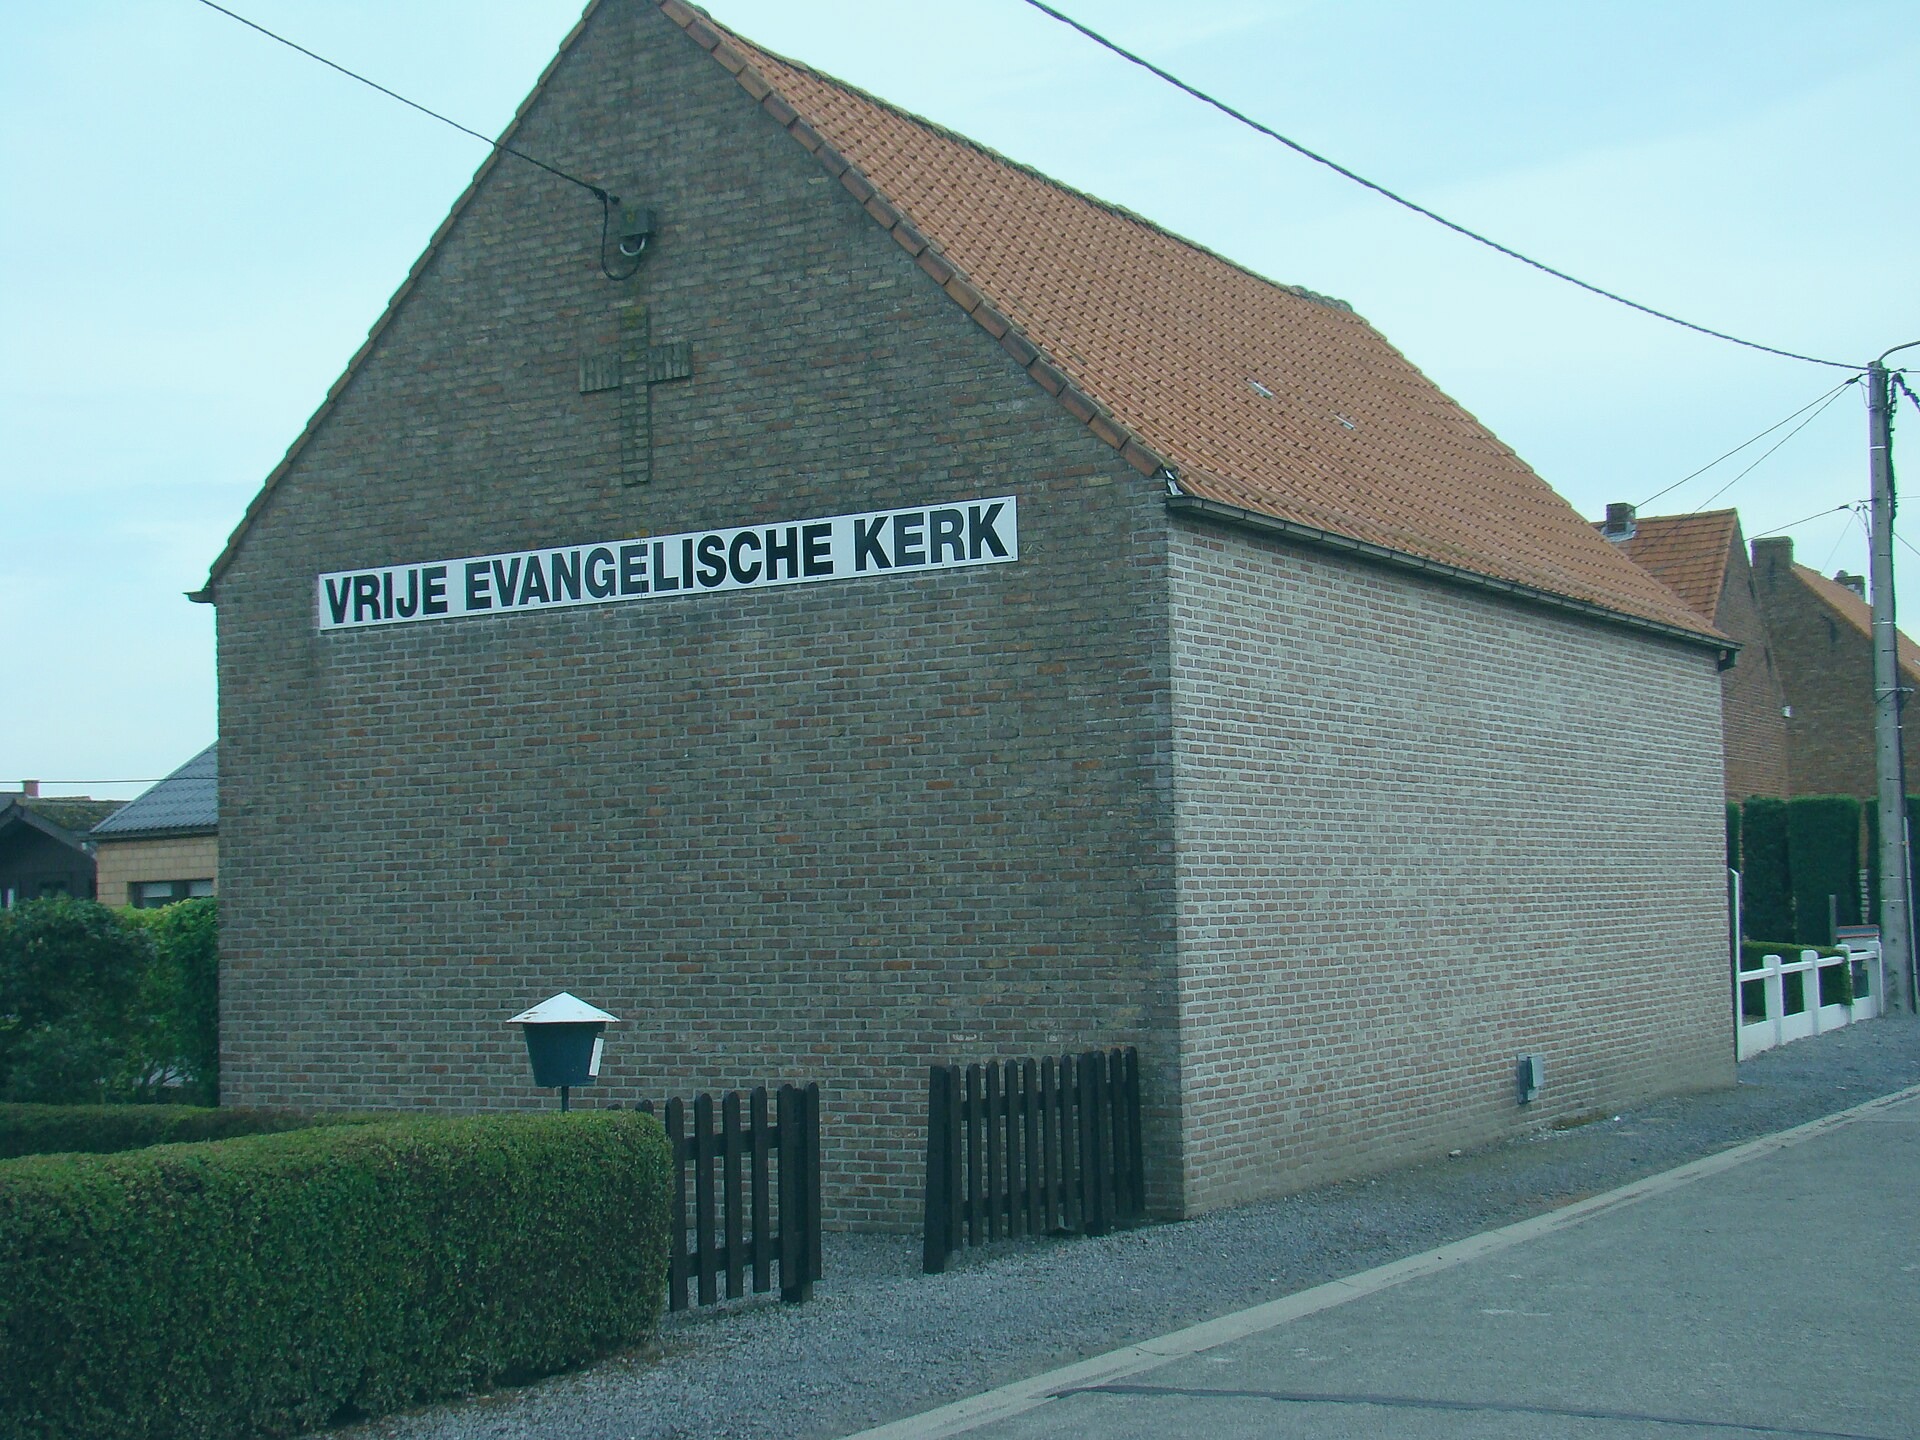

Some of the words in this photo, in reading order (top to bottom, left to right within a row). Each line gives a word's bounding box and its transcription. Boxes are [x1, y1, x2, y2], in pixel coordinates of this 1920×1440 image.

[325, 567, 447, 624] VRIJE
[465, 523, 833, 609] EVANGELISCHE
[854, 504, 1009, 572] KERK
